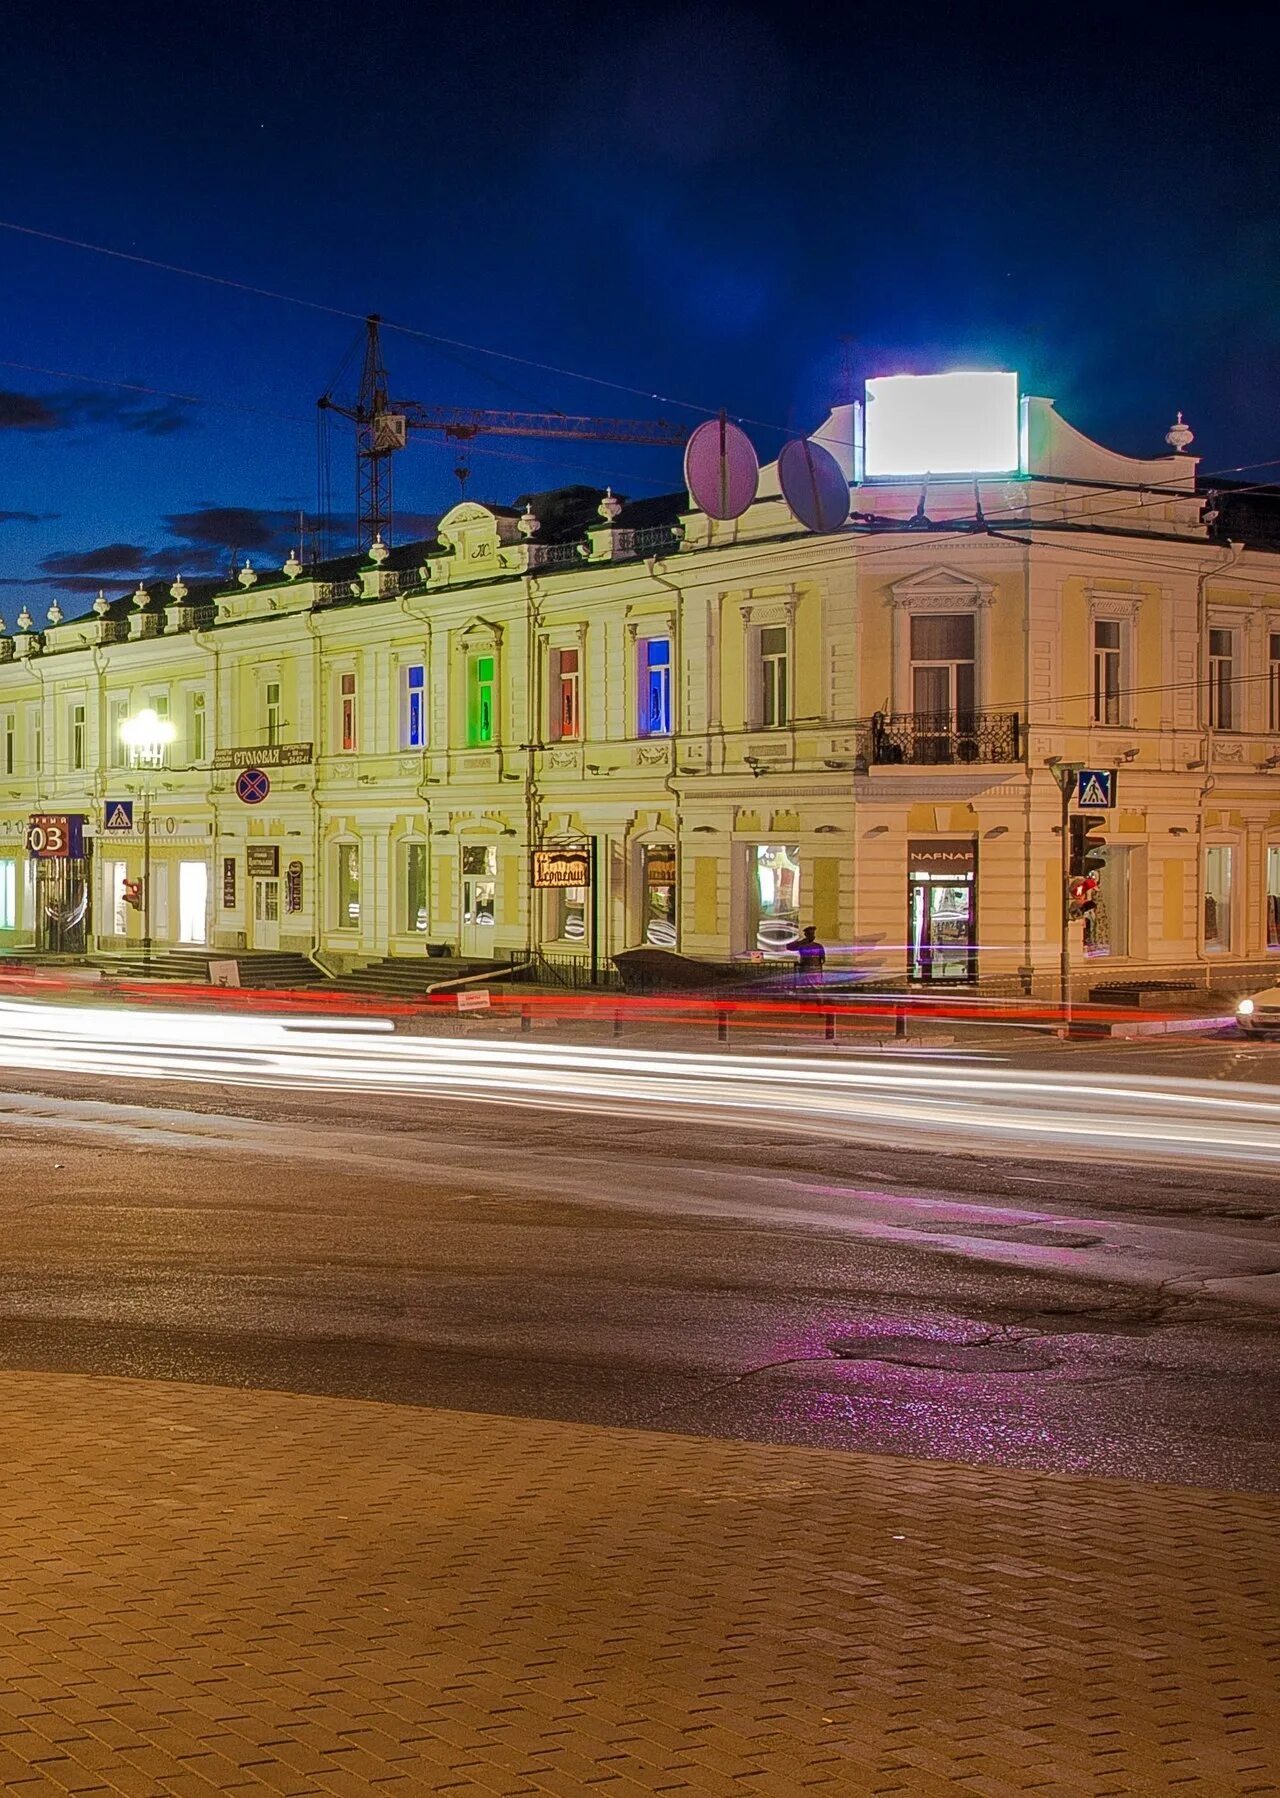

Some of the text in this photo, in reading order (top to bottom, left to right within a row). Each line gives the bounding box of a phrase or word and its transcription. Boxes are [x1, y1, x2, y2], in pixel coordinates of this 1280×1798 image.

[234, 749, 279, 766] СТОЛОВАЯ
[95, 817, 177, 835] ЗОТО
[911, 852, 973, 860] NAFNAF
